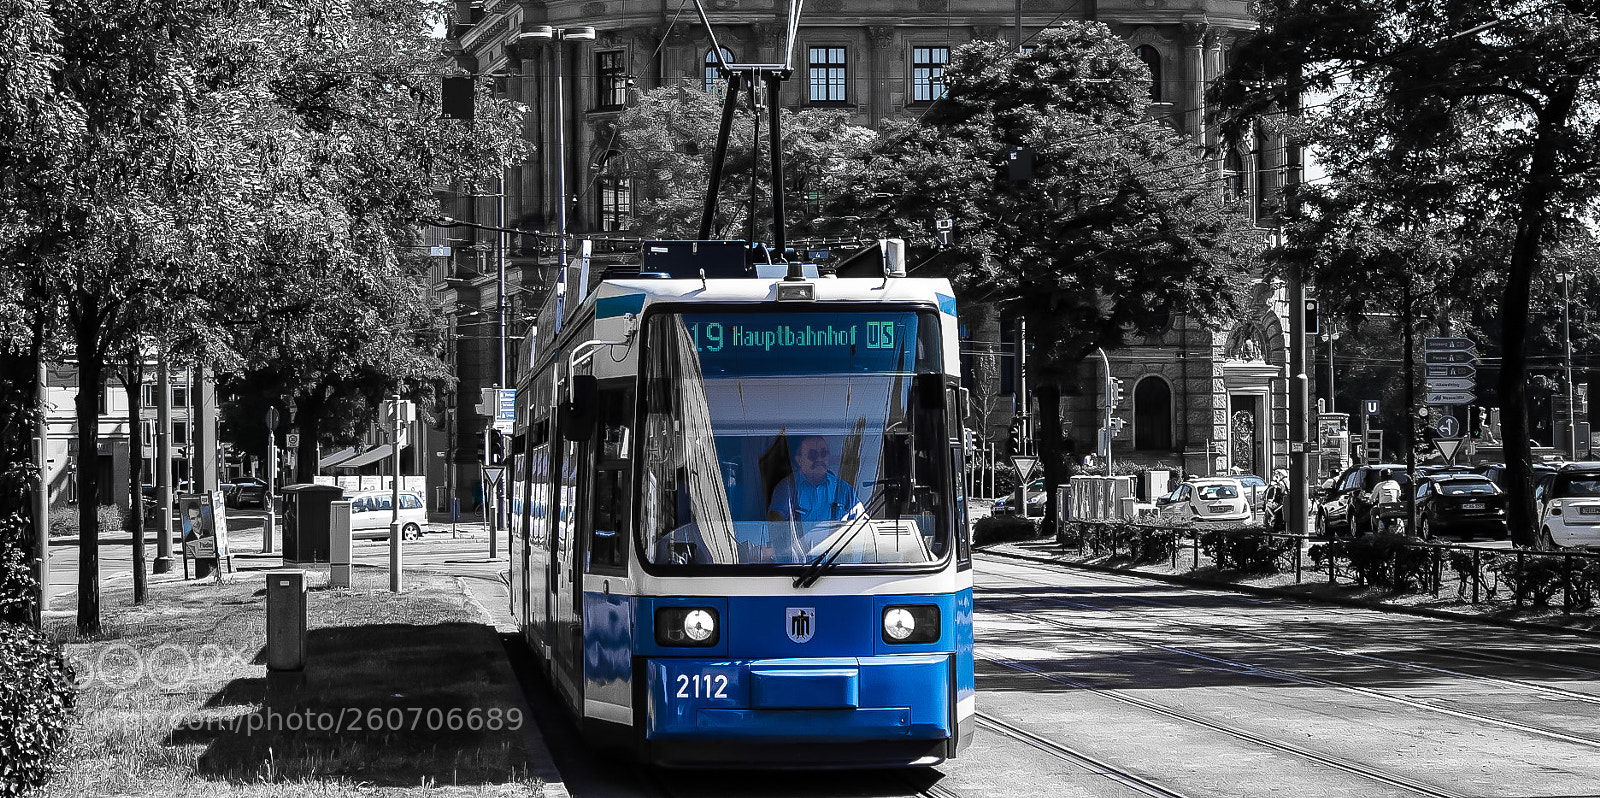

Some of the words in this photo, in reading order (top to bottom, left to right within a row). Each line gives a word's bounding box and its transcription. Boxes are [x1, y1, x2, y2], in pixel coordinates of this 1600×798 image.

[691, 322, 724, 352] 19
[733, 325, 857, 351] Hauptbahnhof
[1368, 402, 1376, 412] U
[676, 674, 728, 699] 2112
